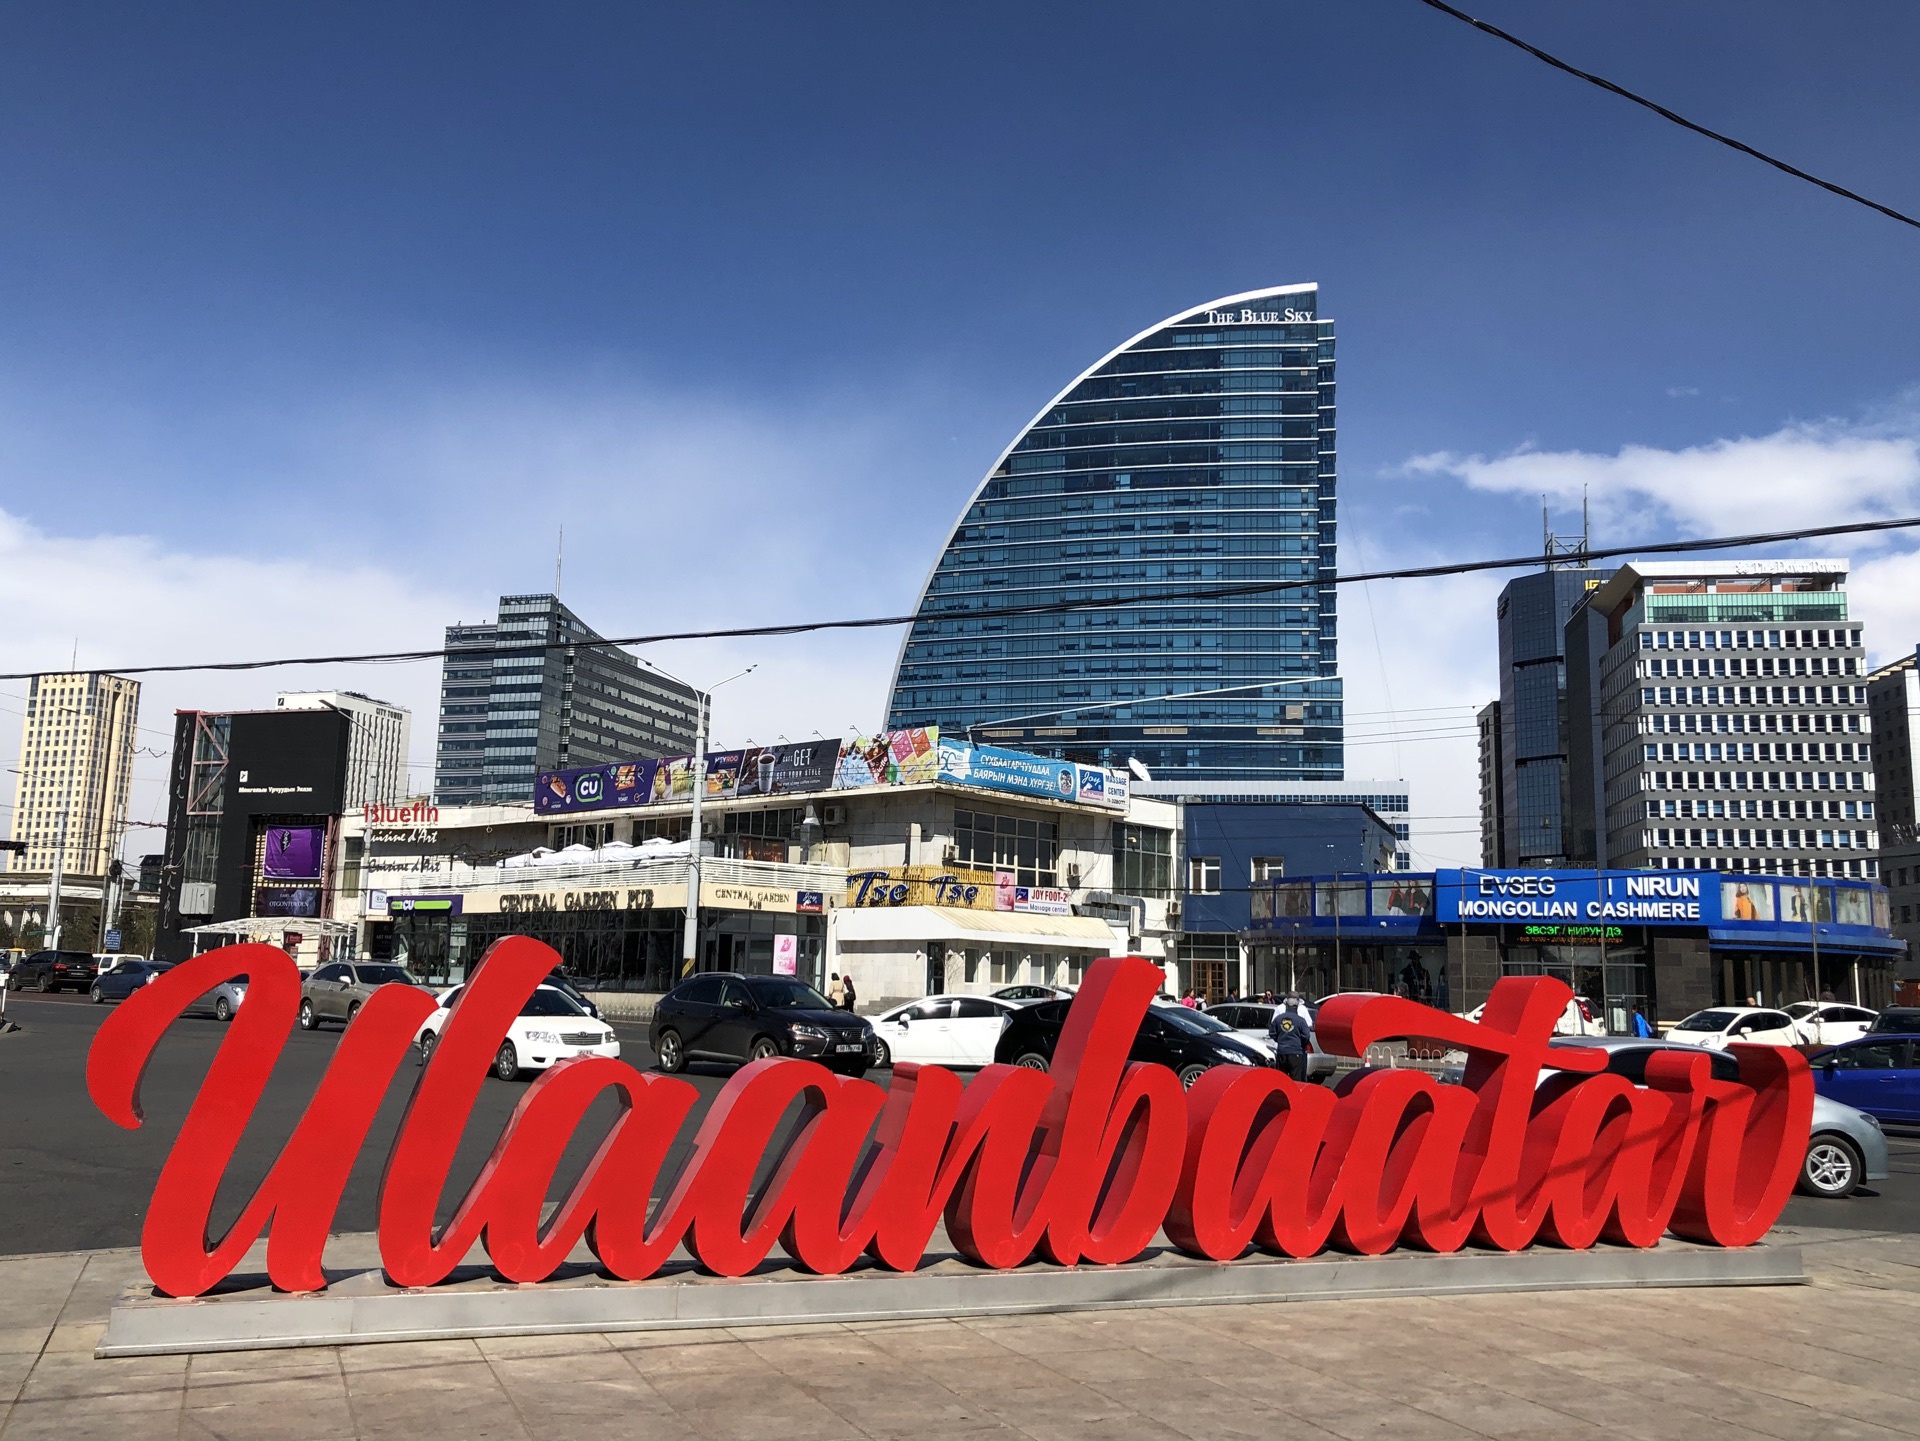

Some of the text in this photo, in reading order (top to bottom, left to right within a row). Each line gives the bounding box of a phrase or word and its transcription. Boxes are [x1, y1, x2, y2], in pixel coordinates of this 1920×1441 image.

[1204, 308, 1313, 324] THE BLUE SKY
[376, 708, 403, 720] CITY TOWER
[793, 748, 812, 766] GET
[973, 768, 1005, 782] БАЯРЫН
[1007, 774, 1028, 787] МЭНД
[1082, 771, 1102, 786] Joy
[1105, 774, 1127, 786] MASSAGE
[580, 781, 598, 795] CU
[1108, 787, 1125, 797] CENTER
[364, 802, 438, 822] Bluefin
[846, 871, 910, 903] Tse
[929, 875, 979, 901] Tse
[1479, 876, 1556, 896] EVSEG
[1627, 877, 1700, 897] NIRUN
[499, 889, 654, 912] CENTRAL GARDEN PUB
[715, 888, 790, 903] CENTRAL GARDEN
[1032, 889, 1068, 902] JOY FOOT-2
[403, 900, 414, 910] CU
[748, 900, 762, 910] PUB
[1030, 904, 1051, 912] Massage
[1458, 901, 1700, 919] MONGOLIAN CASHMERE
[1525, 926, 1560, 935] ЭВСЭГ
[87, 935, 1815, 1298] Ulaanbaatar
